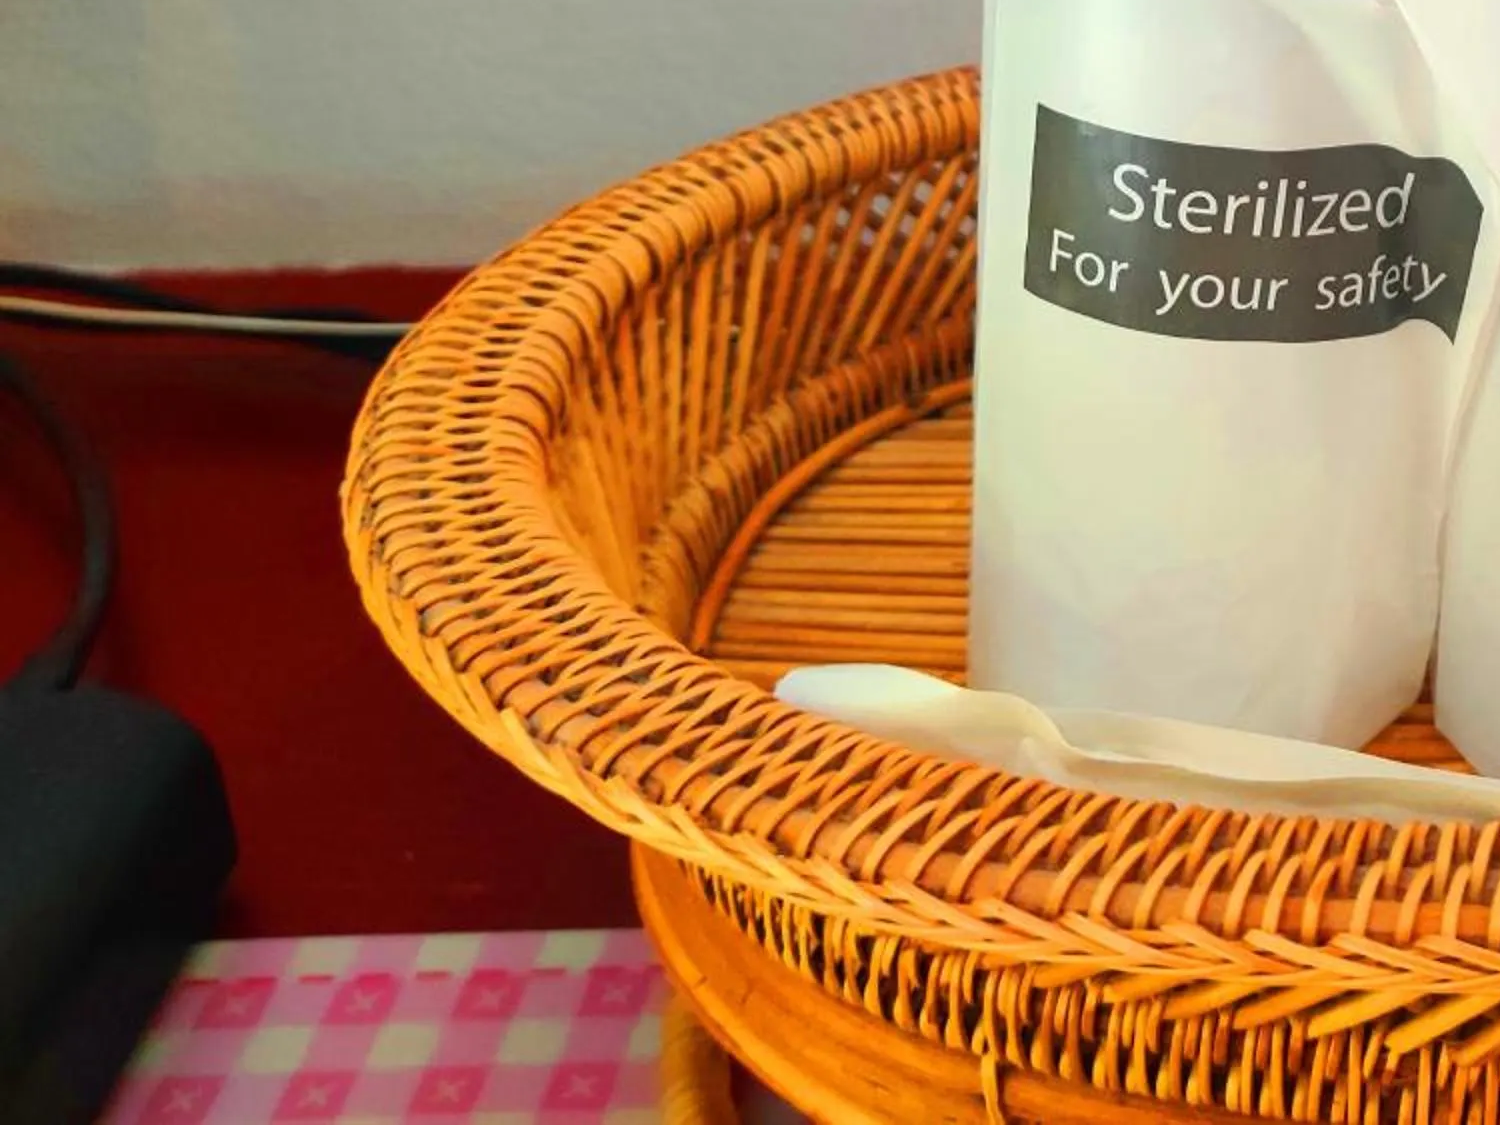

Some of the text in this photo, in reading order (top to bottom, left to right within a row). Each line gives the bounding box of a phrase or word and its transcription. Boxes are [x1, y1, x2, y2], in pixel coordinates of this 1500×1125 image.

[1108, 163, 1416, 237] Sterilized
[1049, 229, 1447, 315] For your safety
